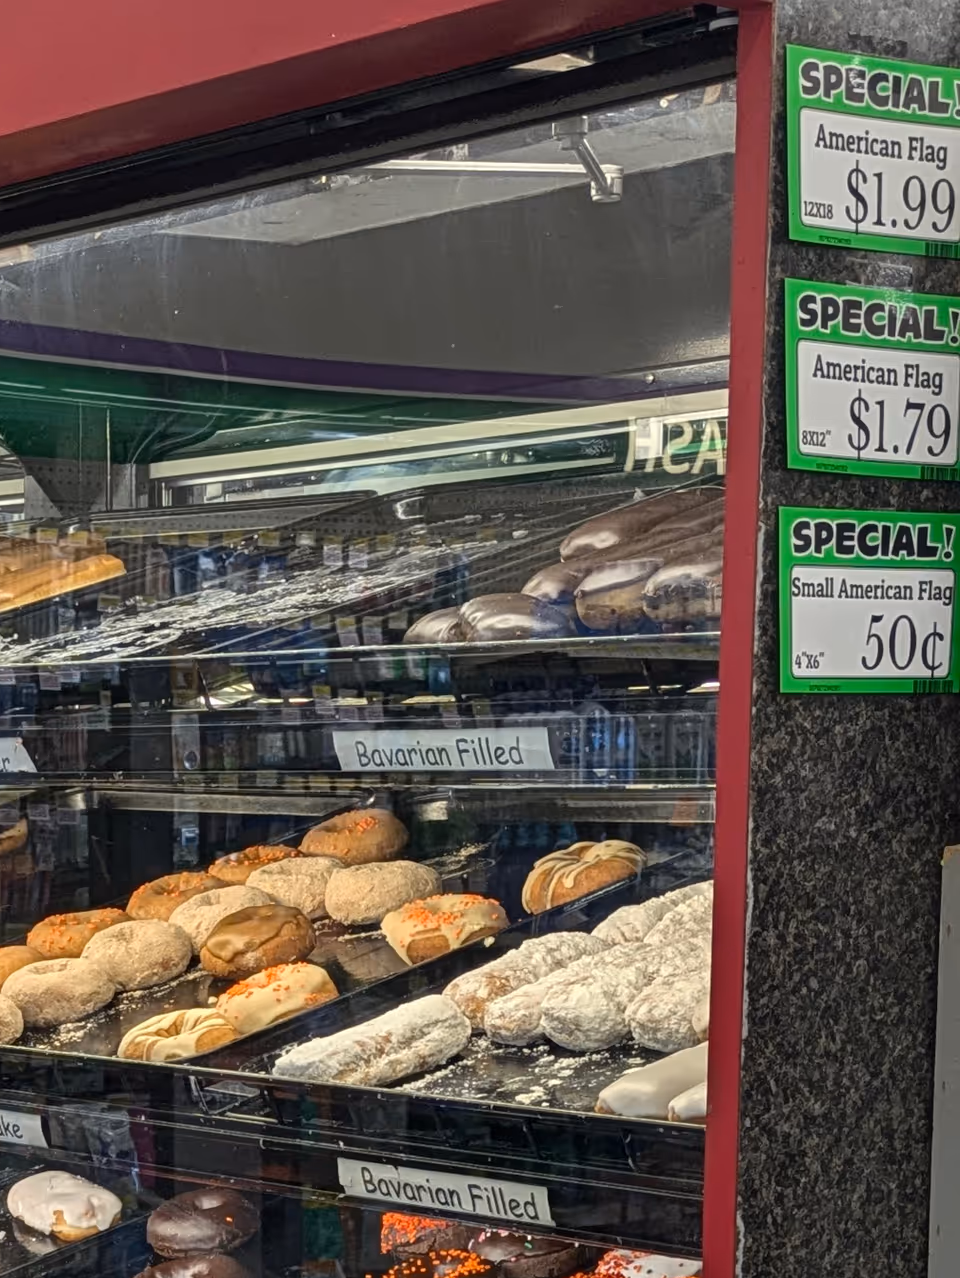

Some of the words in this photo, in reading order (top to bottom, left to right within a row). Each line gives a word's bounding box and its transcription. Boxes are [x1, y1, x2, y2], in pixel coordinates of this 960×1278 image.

[815, 123, 902, 159] American
[908, 136, 948, 170] Flag
[804, 201, 833, 219] 12X18
[845, 160, 955, 235] $1.99
[797, 292, 960, 347] SPECIAL!
[813, 354, 898, 386] American
[903, 364, 943, 396] Flag
[848, 389, 951, 460] $1.79
[792, 518, 956, 562] SPECIAL!
[792, 577, 834, 599] Small
[838, 578, 913, 600] American
[918, 581, 953, 606] Flag
[861, 614, 944, 679] 50¢
[355, 740, 452, 768] Bavarian
[455, 736, 524, 767] Filled
[361, 1167, 462, 1209] Bavarian
[468, 1184, 539, 1220] Filled
